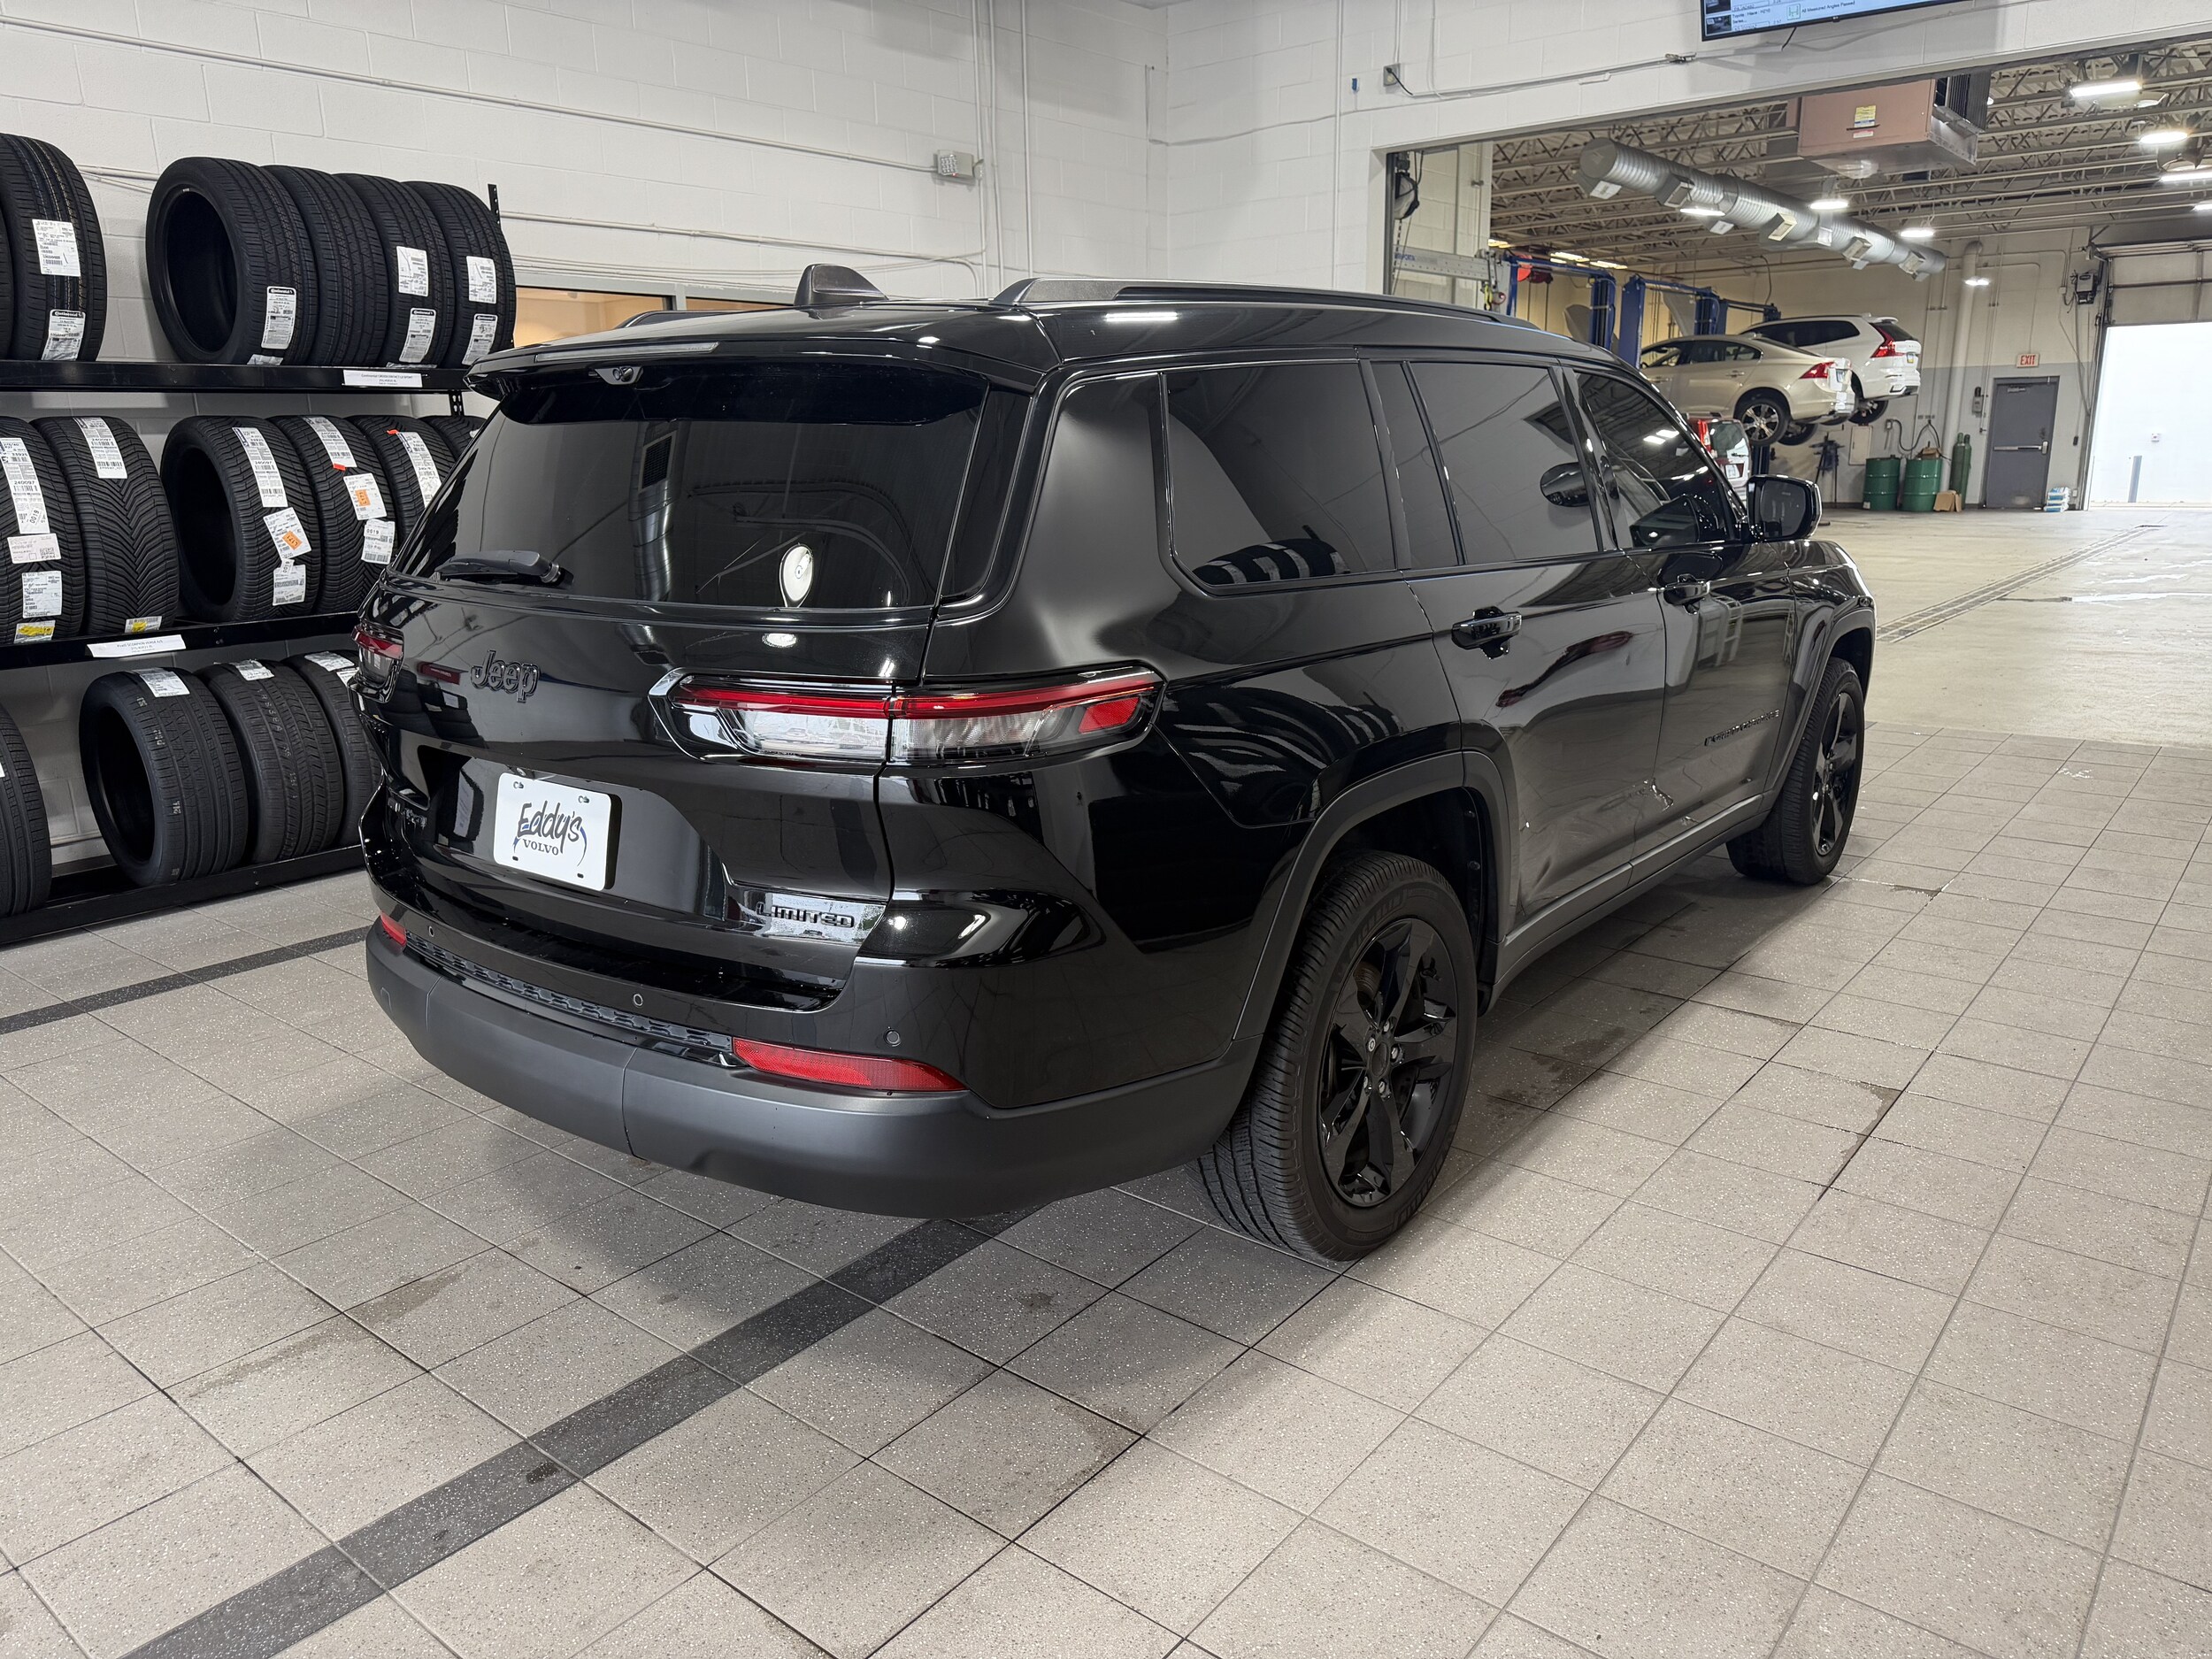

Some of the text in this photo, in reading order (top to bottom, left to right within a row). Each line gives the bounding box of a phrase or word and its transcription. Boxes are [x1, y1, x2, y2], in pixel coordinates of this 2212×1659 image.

[2020, 355, 2036, 365] EXIT
[471, 649, 541, 703] Jeep
[517, 800, 582, 854] Eddy's
[523, 839, 559, 856] VOLVO
[757, 902, 855, 928] LIMITED
